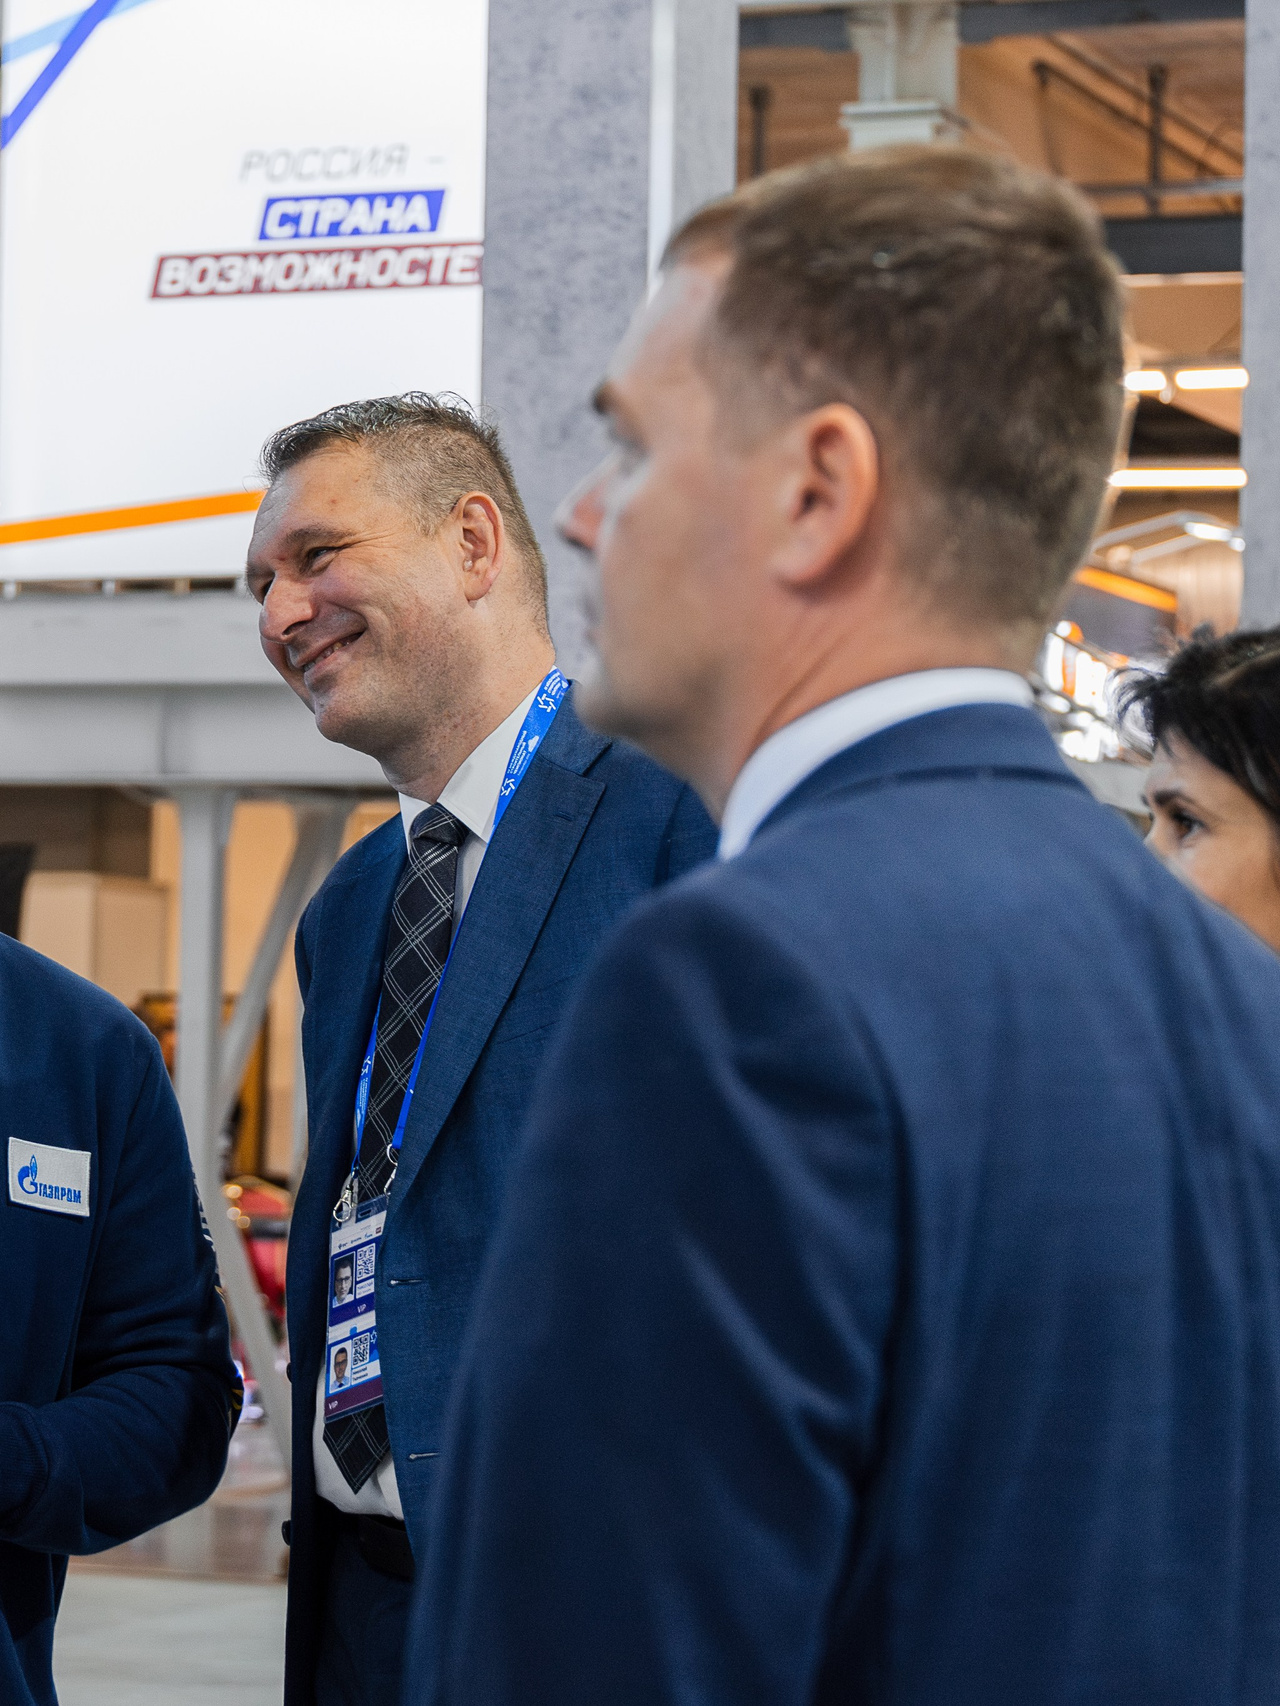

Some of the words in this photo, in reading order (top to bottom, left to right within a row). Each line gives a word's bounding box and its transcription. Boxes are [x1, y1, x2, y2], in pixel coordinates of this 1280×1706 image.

[239, 143, 410, 183] РОССИЯ
[263, 193, 433, 240] СТРАНА
[156, 244, 483, 296] ВОЗМОЖНОСТЕ
[39, 1183, 81, 1204] ГАЗПРОМ
